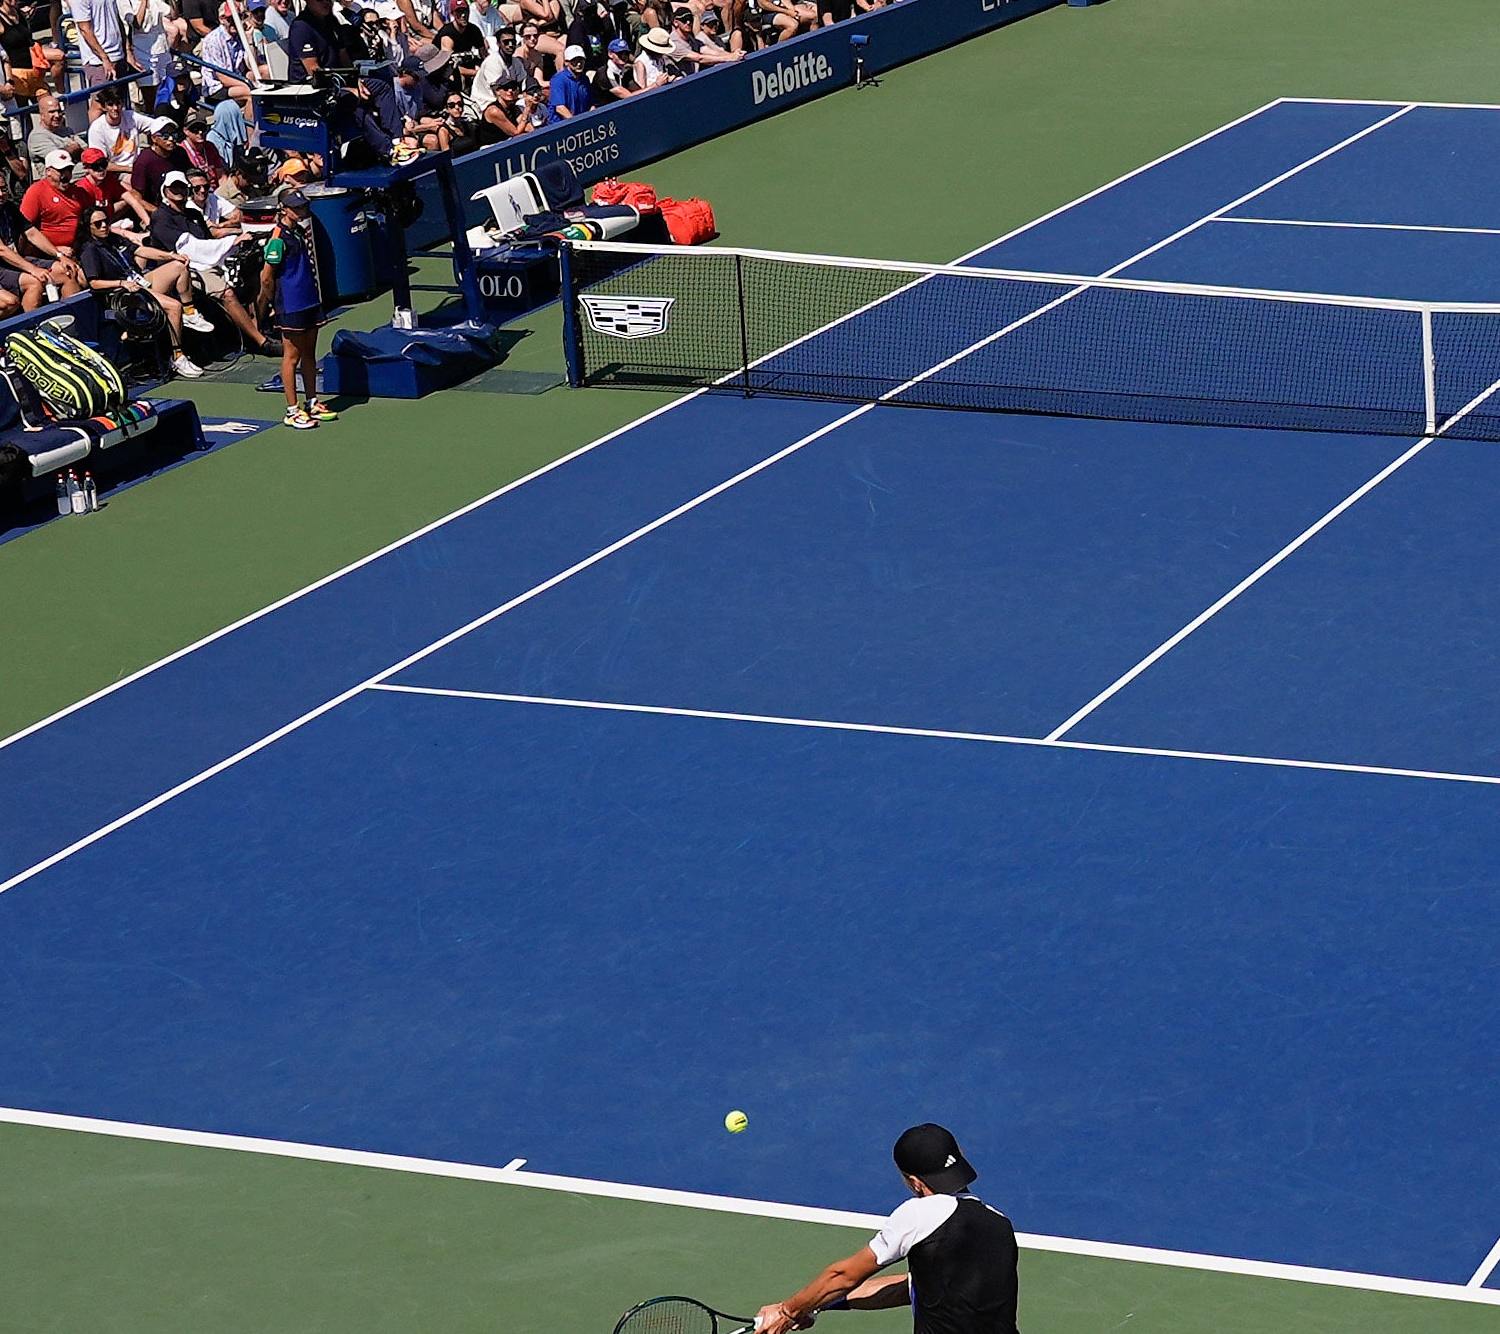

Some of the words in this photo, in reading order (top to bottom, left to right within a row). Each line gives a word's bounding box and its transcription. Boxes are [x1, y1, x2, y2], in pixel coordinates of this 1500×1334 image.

[752, 51, 833, 105] Deloitte.
[556, 124, 607, 156] HOTELS
[608, 121, 618, 137] &
[566, 143, 620, 178] ESORTS
[477, 275, 523, 298] OLO
